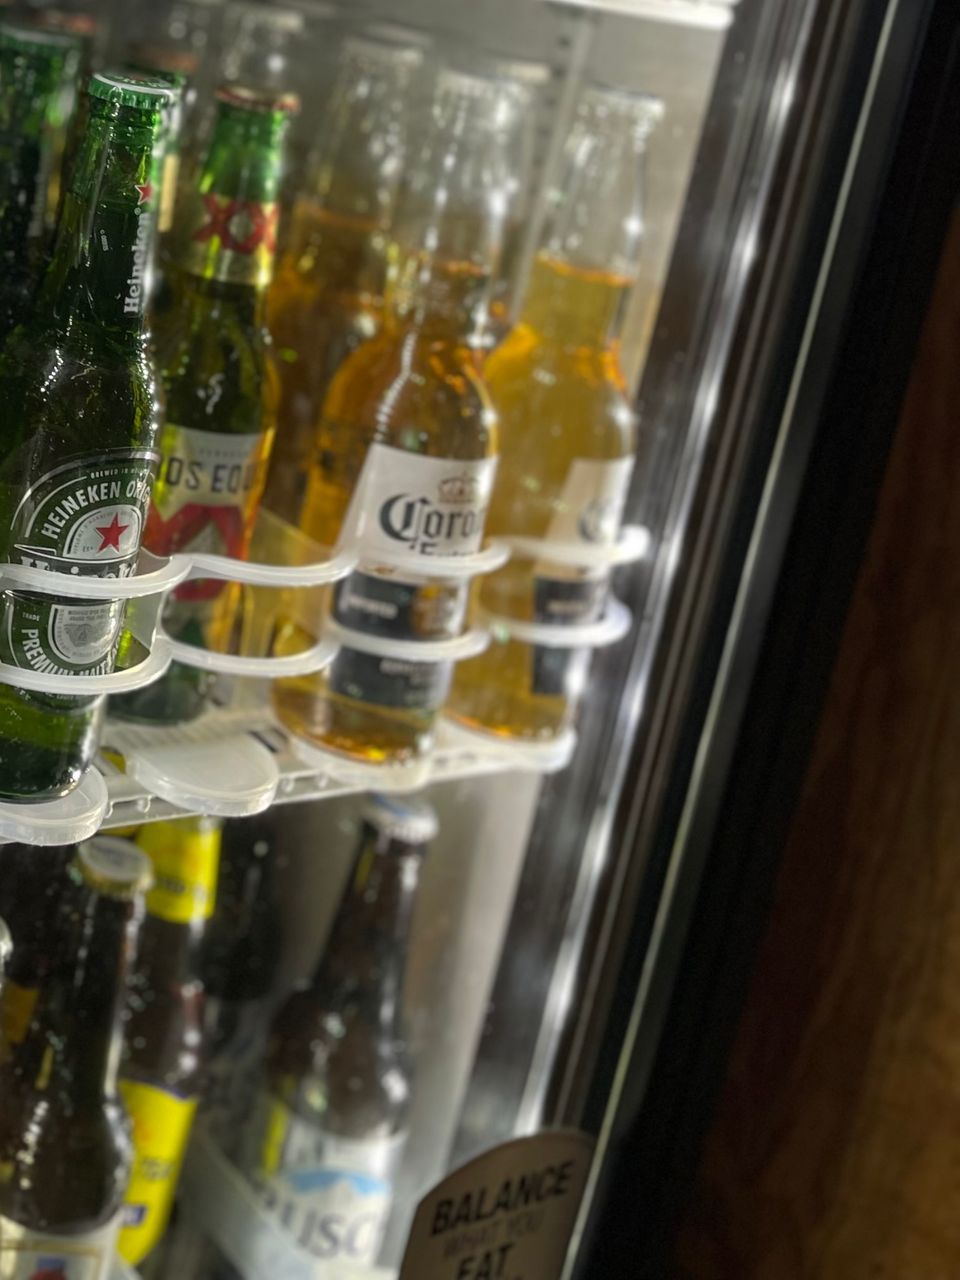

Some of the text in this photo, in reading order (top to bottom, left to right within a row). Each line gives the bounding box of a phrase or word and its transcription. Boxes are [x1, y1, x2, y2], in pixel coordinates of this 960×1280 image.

[124, 213, 150, 314] Heineken
[41, 481, 121, 540] HEINEKEN
[431, 1160, 574, 1237] BALANCE
